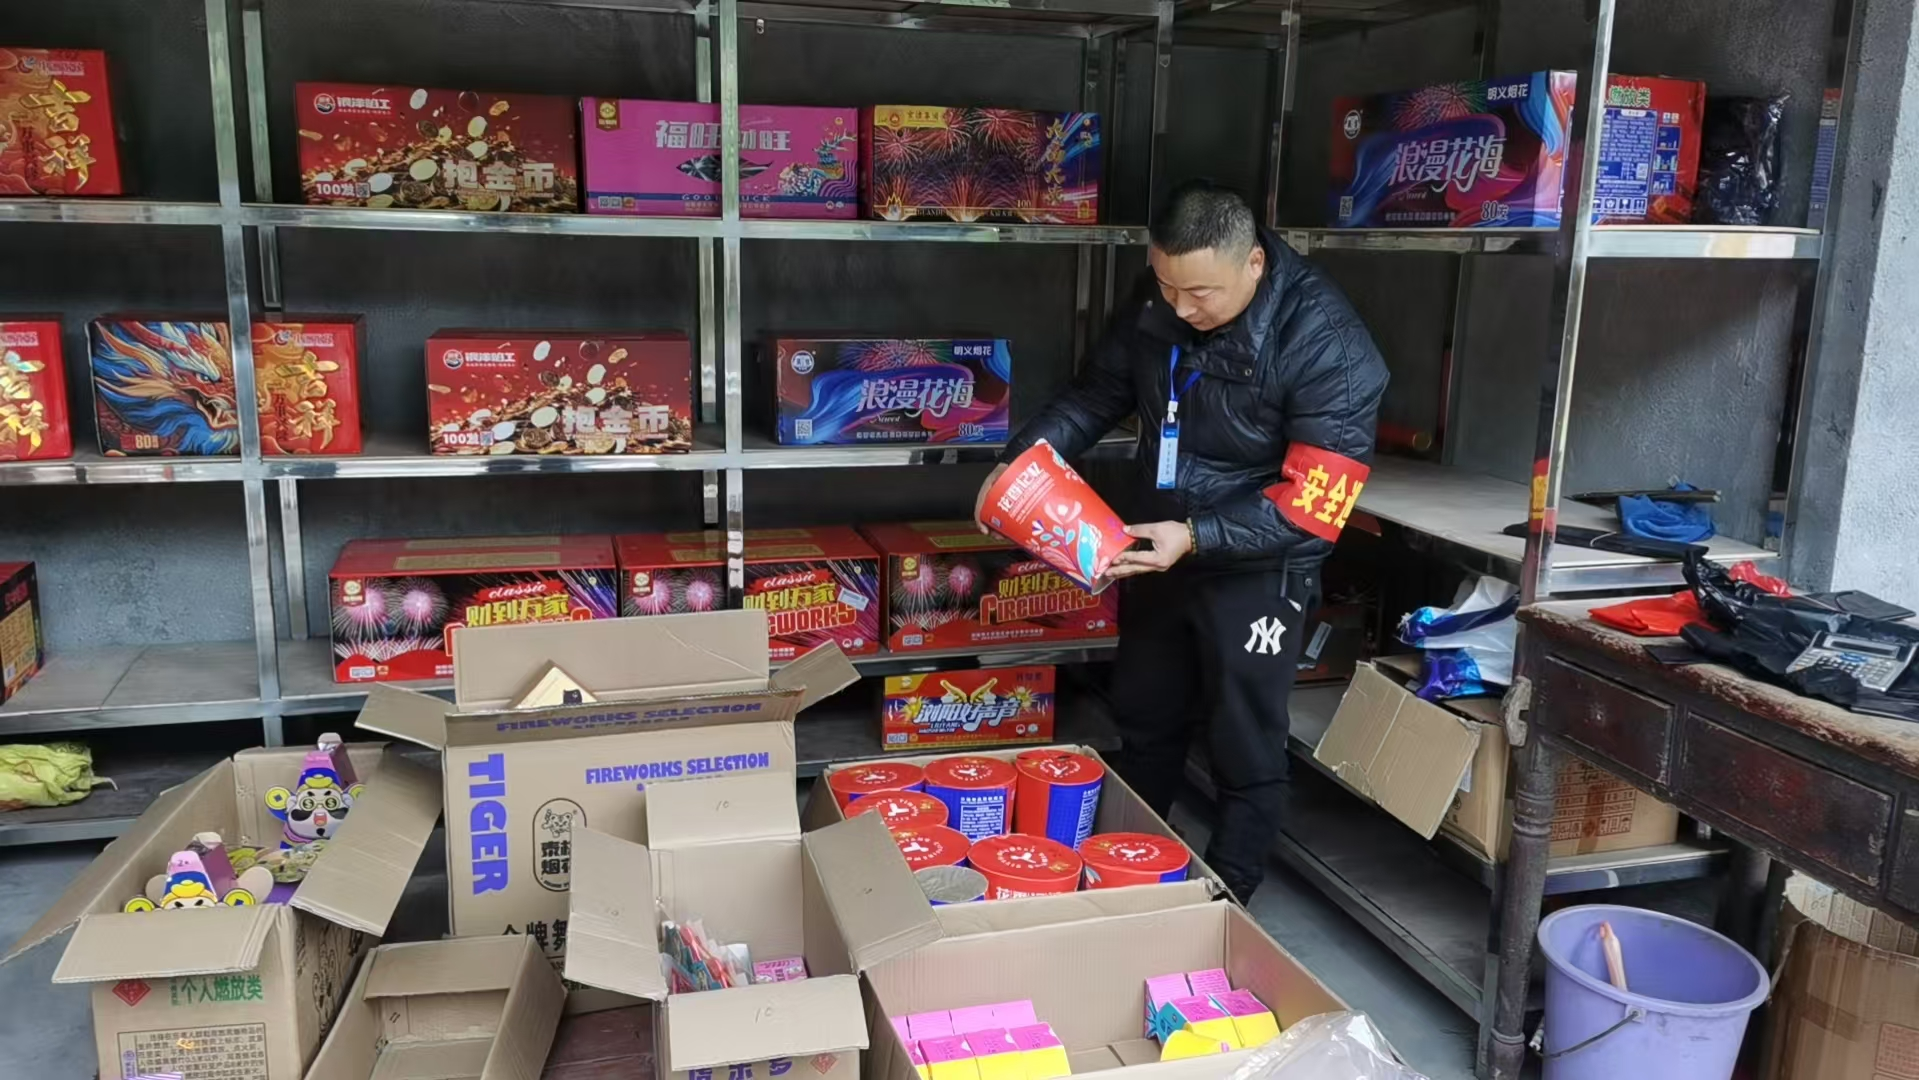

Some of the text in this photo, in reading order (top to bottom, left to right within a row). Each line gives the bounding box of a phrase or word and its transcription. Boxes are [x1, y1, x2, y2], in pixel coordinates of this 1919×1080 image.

[1487, 83, 1529, 100] 明义烟花
[1388, 134, 1507, 193] 浪漫花海
[953, 346, 992, 356] 明义烟花
[274, 351, 341, 450] 吉祥
[856, 377, 976, 418] 浪漫花海
[562, 405, 670, 435] 抱金币
[488, 580, 547, 599] classic
[763, 571, 817, 588] classic
[465, 593, 570, 628] 财到万家
[496, 711, 637, 733] FIREWORKS
[643, 702, 763, 719] SELECTION
[586, 751, 770, 785] FIREWORKS SELECTION
[468, 753, 509, 896] TIGER
[181, 974, 264, 1004] 个人燃放类
